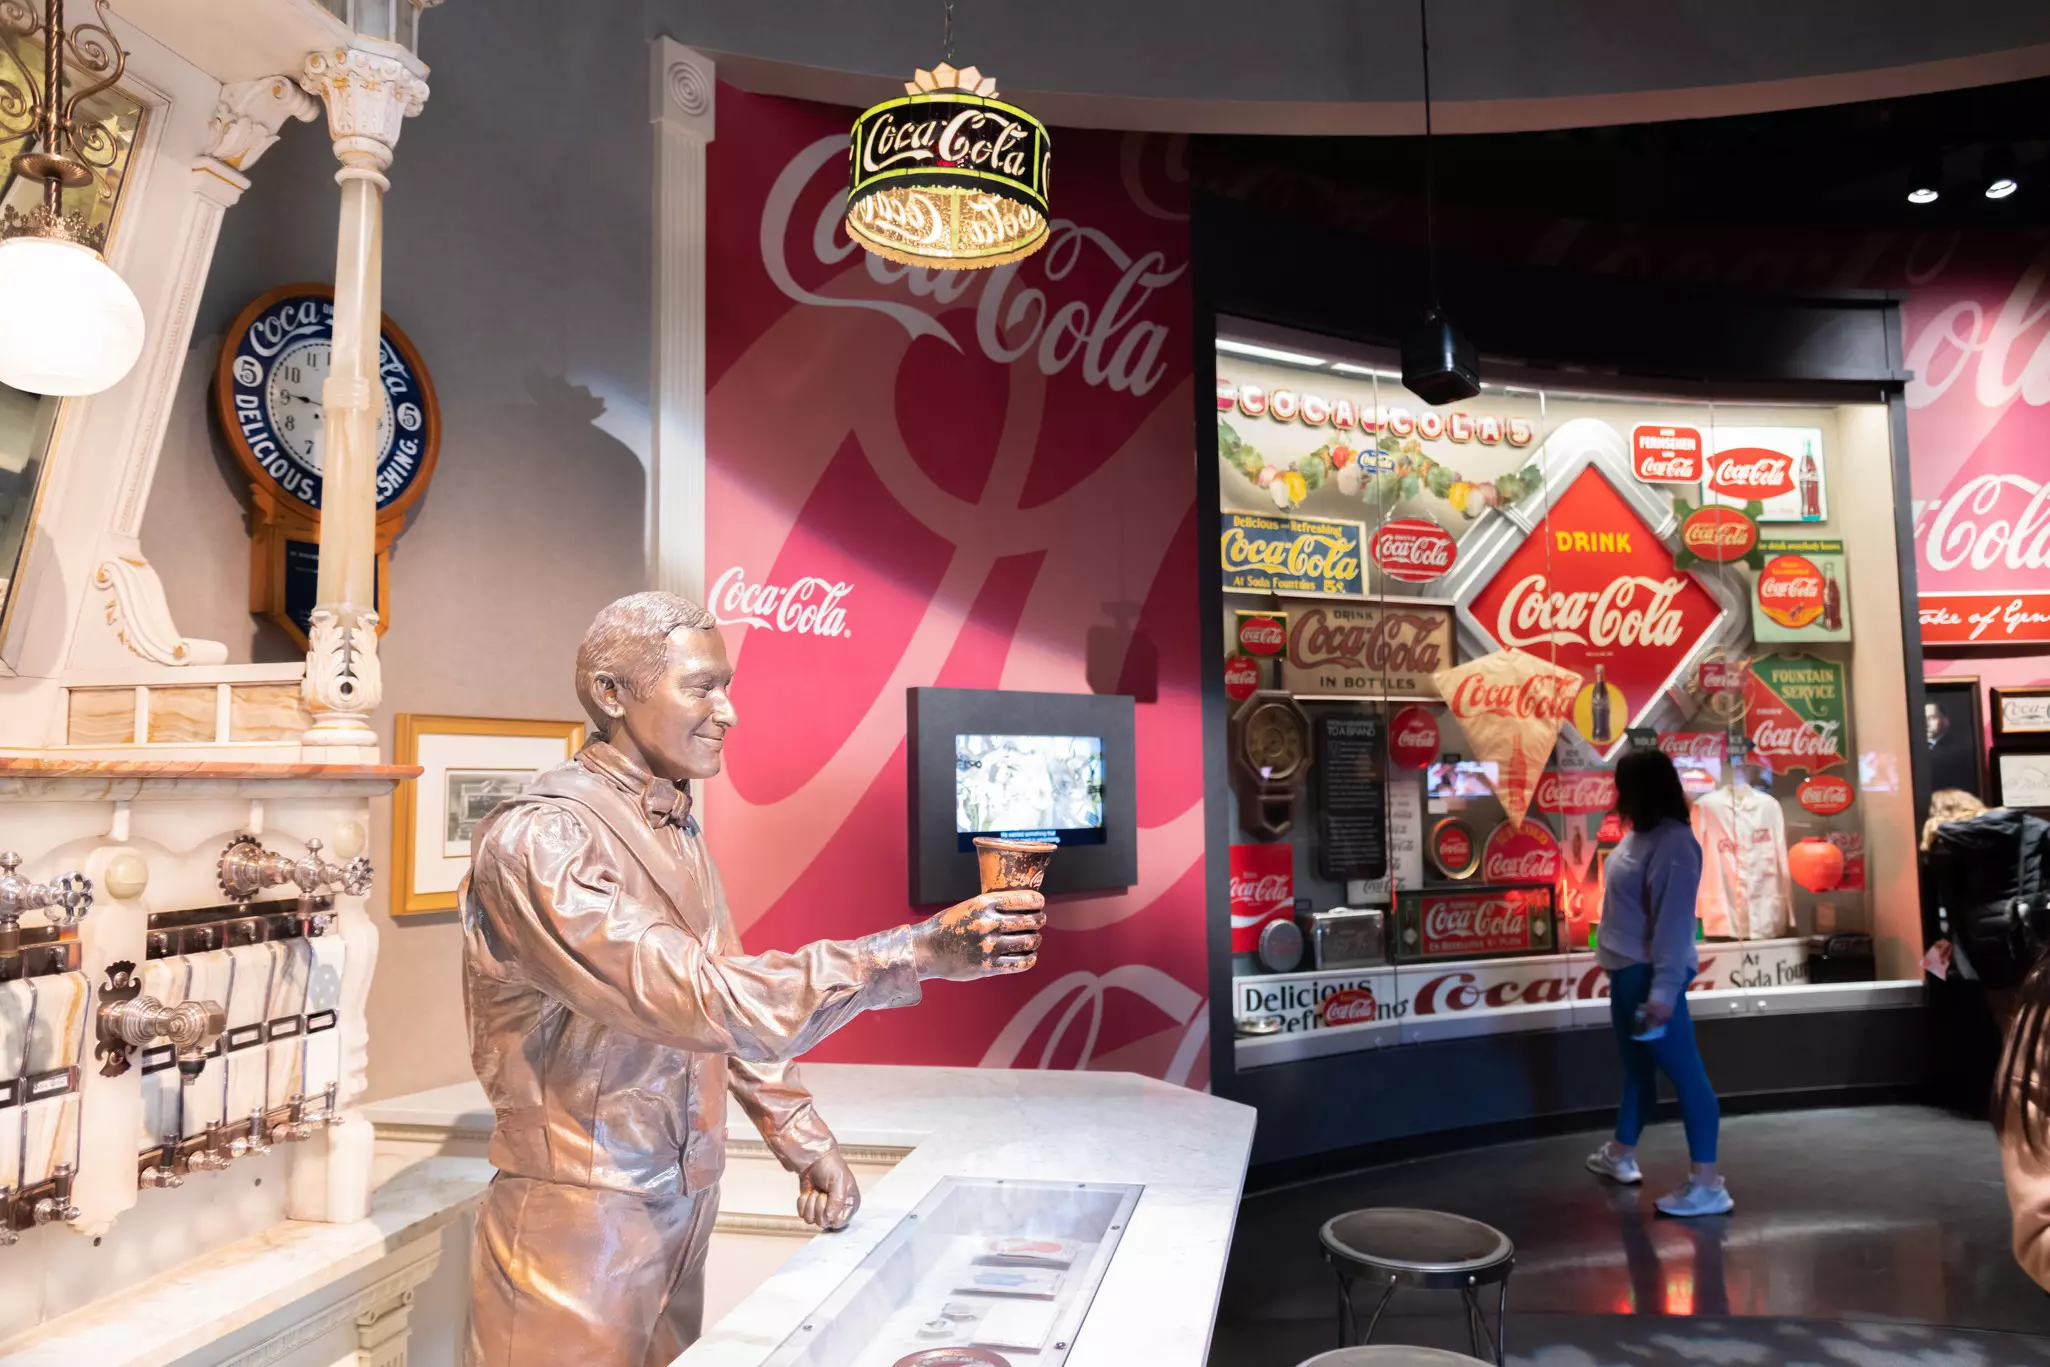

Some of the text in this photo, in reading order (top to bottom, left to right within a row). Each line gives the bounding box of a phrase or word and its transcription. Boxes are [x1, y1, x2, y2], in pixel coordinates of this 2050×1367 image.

[863, 109, 1028, 177] Coca-Cola
[284, 365, 301, 384] 10
[284, 415, 295, 432] 8
[235, 394, 317, 506] DELICIOUS.
[304, 440, 314, 455] 7
[1640, 456, 1694, 478] Coca-Cola
[1716, 458, 1786, 487] Coca-Cola
[1233, 515, 1343, 539] Delicious Refreshing
[1685, 524, 1749, 546] Coca-Cola
[1375, 534, 1450, 567] Coca-Cola
[1555, 531, 1633, 553] DRINK
[1220, 528, 1359, 581] Coca-Cola
[1247, 575, 1270, 588] Soda
[1272, 577, 1316, 591] Fountains
[1761, 576, 1819, 598] Coca-Cola
[1333, 609, 1374, 621] DRINK
[1497, 574, 1688, 648] Coca-Cola
[1968, 605, 2001, 640] of
[1289, 608, 1446, 675] Coca-Cola
[1320, 676, 1416, 690] IN BOTTLES
[1771, 669, 1834, 683] FOUNTAIN
[1452, 672, 1577, 720] Coca-Cola
[1781, 684, 1836, 699] SERVICE
[1660, 734, 1723, 756] Coca-Cola
[1752, 719, 1841, 756] Coca-Cola
[1538, 776, 1614, 808] Coca-Cola
[1488, 849, 1557, 879] Coca-Cola
[1426, 900, 1528, 940] Coca-Cola
[1245, 979, 1373, 1013] Delicious
[1325, 1000, 1373, 1021] Coca-Cola
